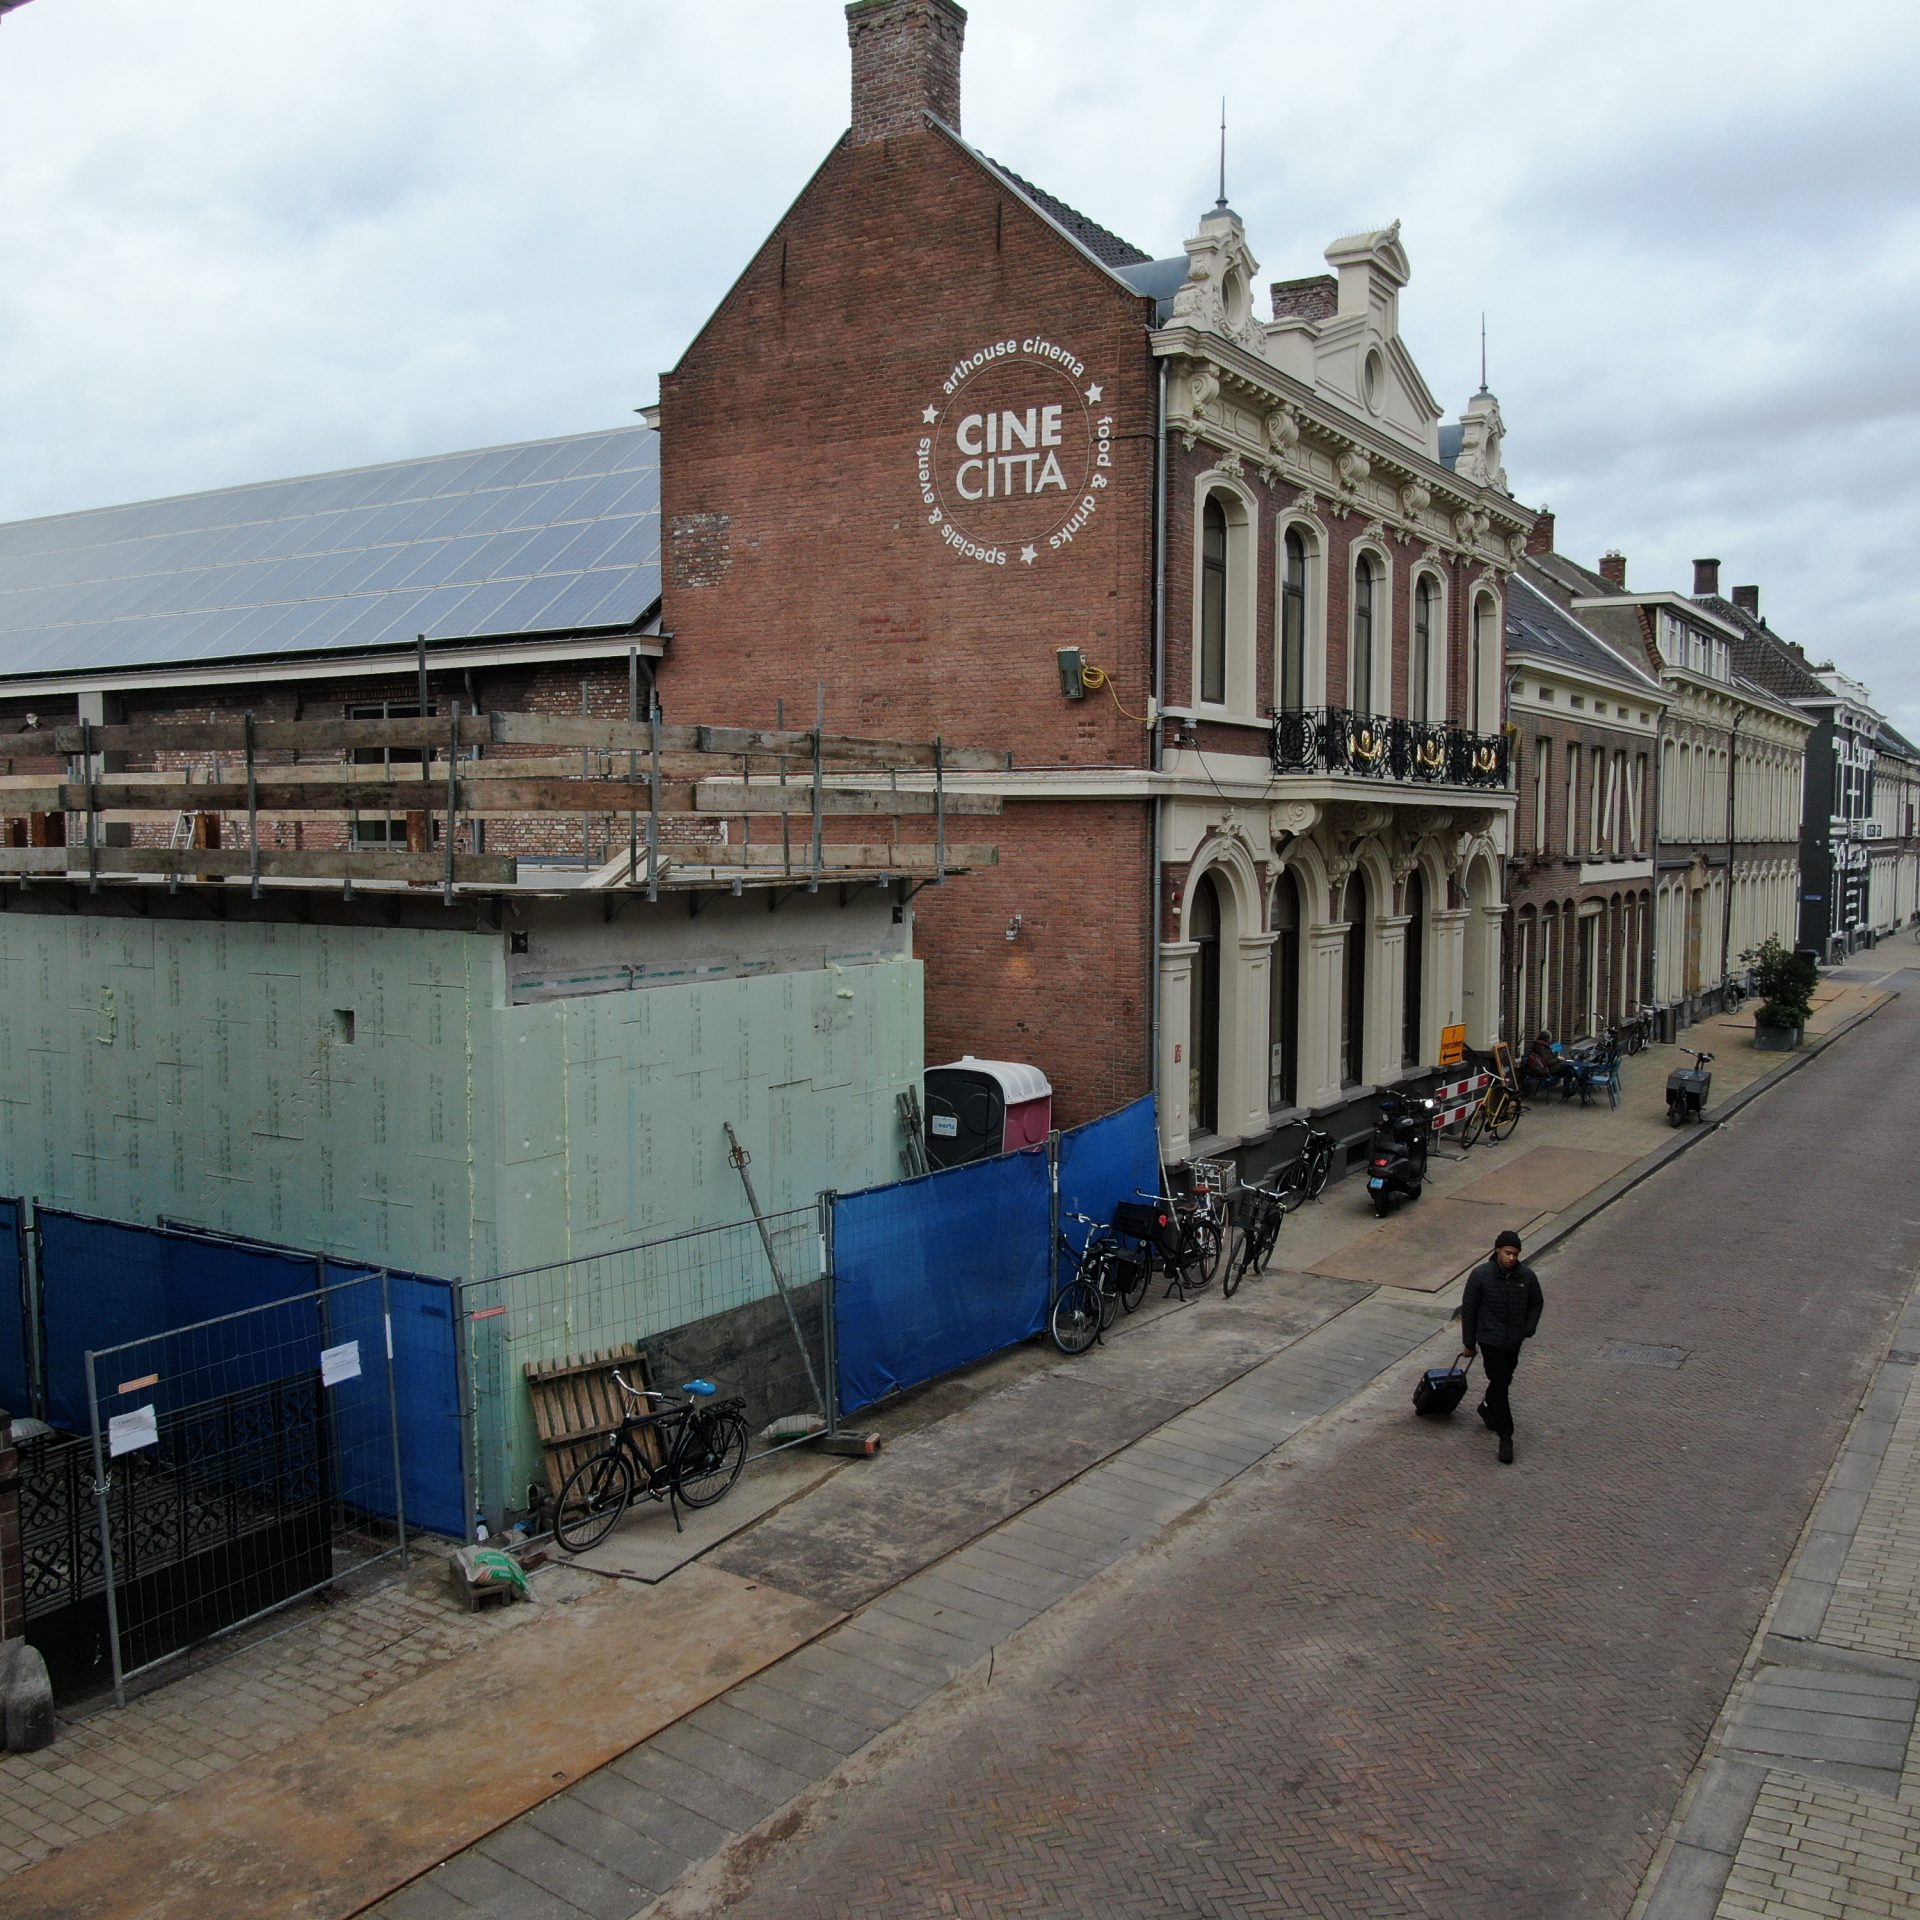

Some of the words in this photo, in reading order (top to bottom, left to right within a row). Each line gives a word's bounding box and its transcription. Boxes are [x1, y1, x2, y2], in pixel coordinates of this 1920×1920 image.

[942, 339, 1017, 395] arthouse
[1022, 335, 1085, 378] cinema
[956, 404, 1062, 456] CINE
[1096, 415, 1113, 467] food
[915, 437, 936, 504] events
[956, 449, 1068, 501] CITTA
[1089, 473, 1108, 489] &
[928, 506, 943, 525] &
[1049, 495, 1096, 550] drinks
[940, 523, 1007, 566] specials
